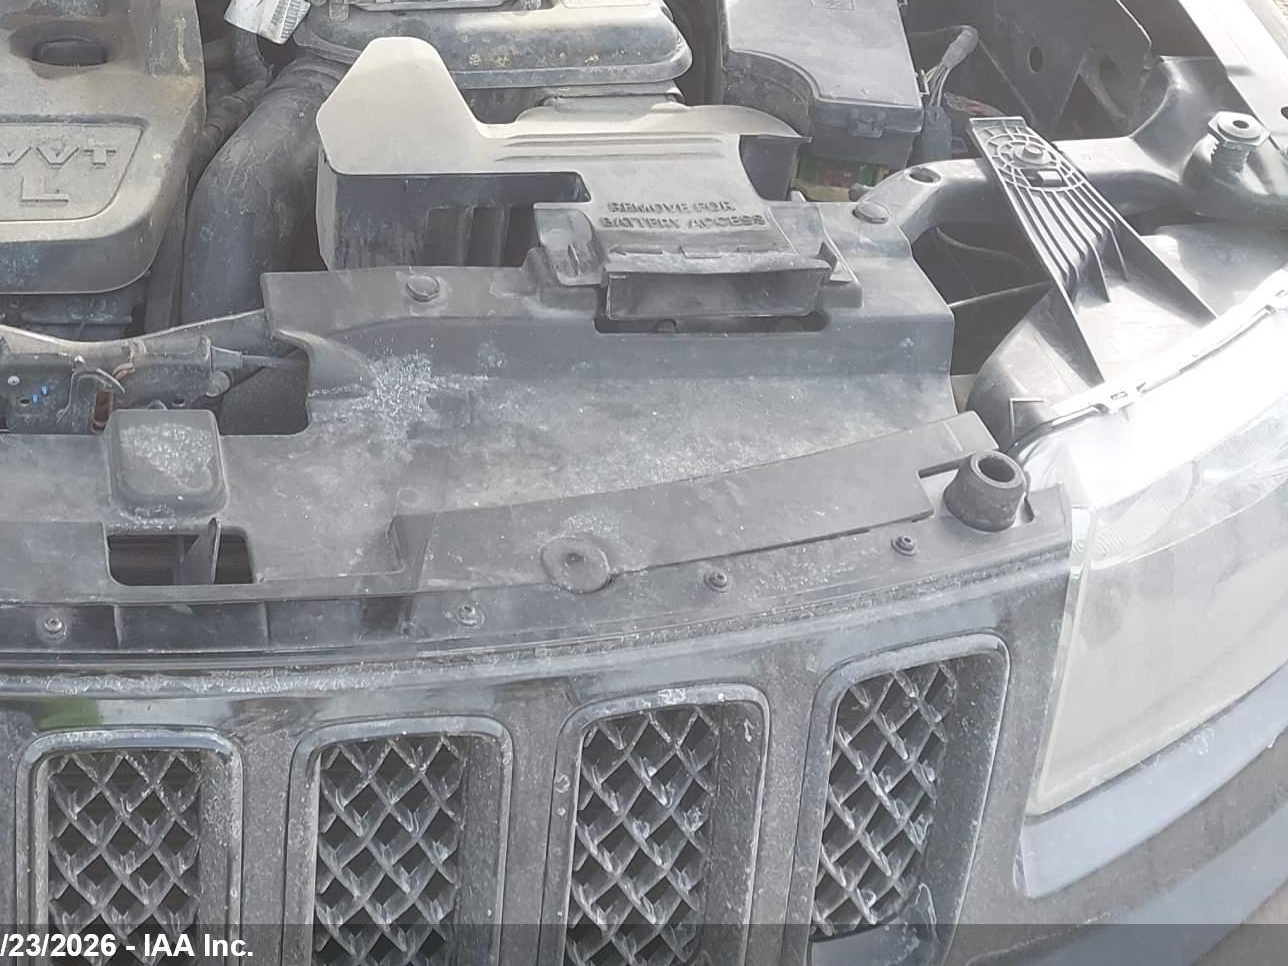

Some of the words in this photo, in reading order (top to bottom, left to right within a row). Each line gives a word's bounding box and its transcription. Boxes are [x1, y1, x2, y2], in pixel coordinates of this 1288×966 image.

[607, 201, 691, 214] REMOVE
[692, 200, 737, 213] FOR
[600, 216, 682, 229] BATTERY
[687, 214, 767, 228] ACCESS
